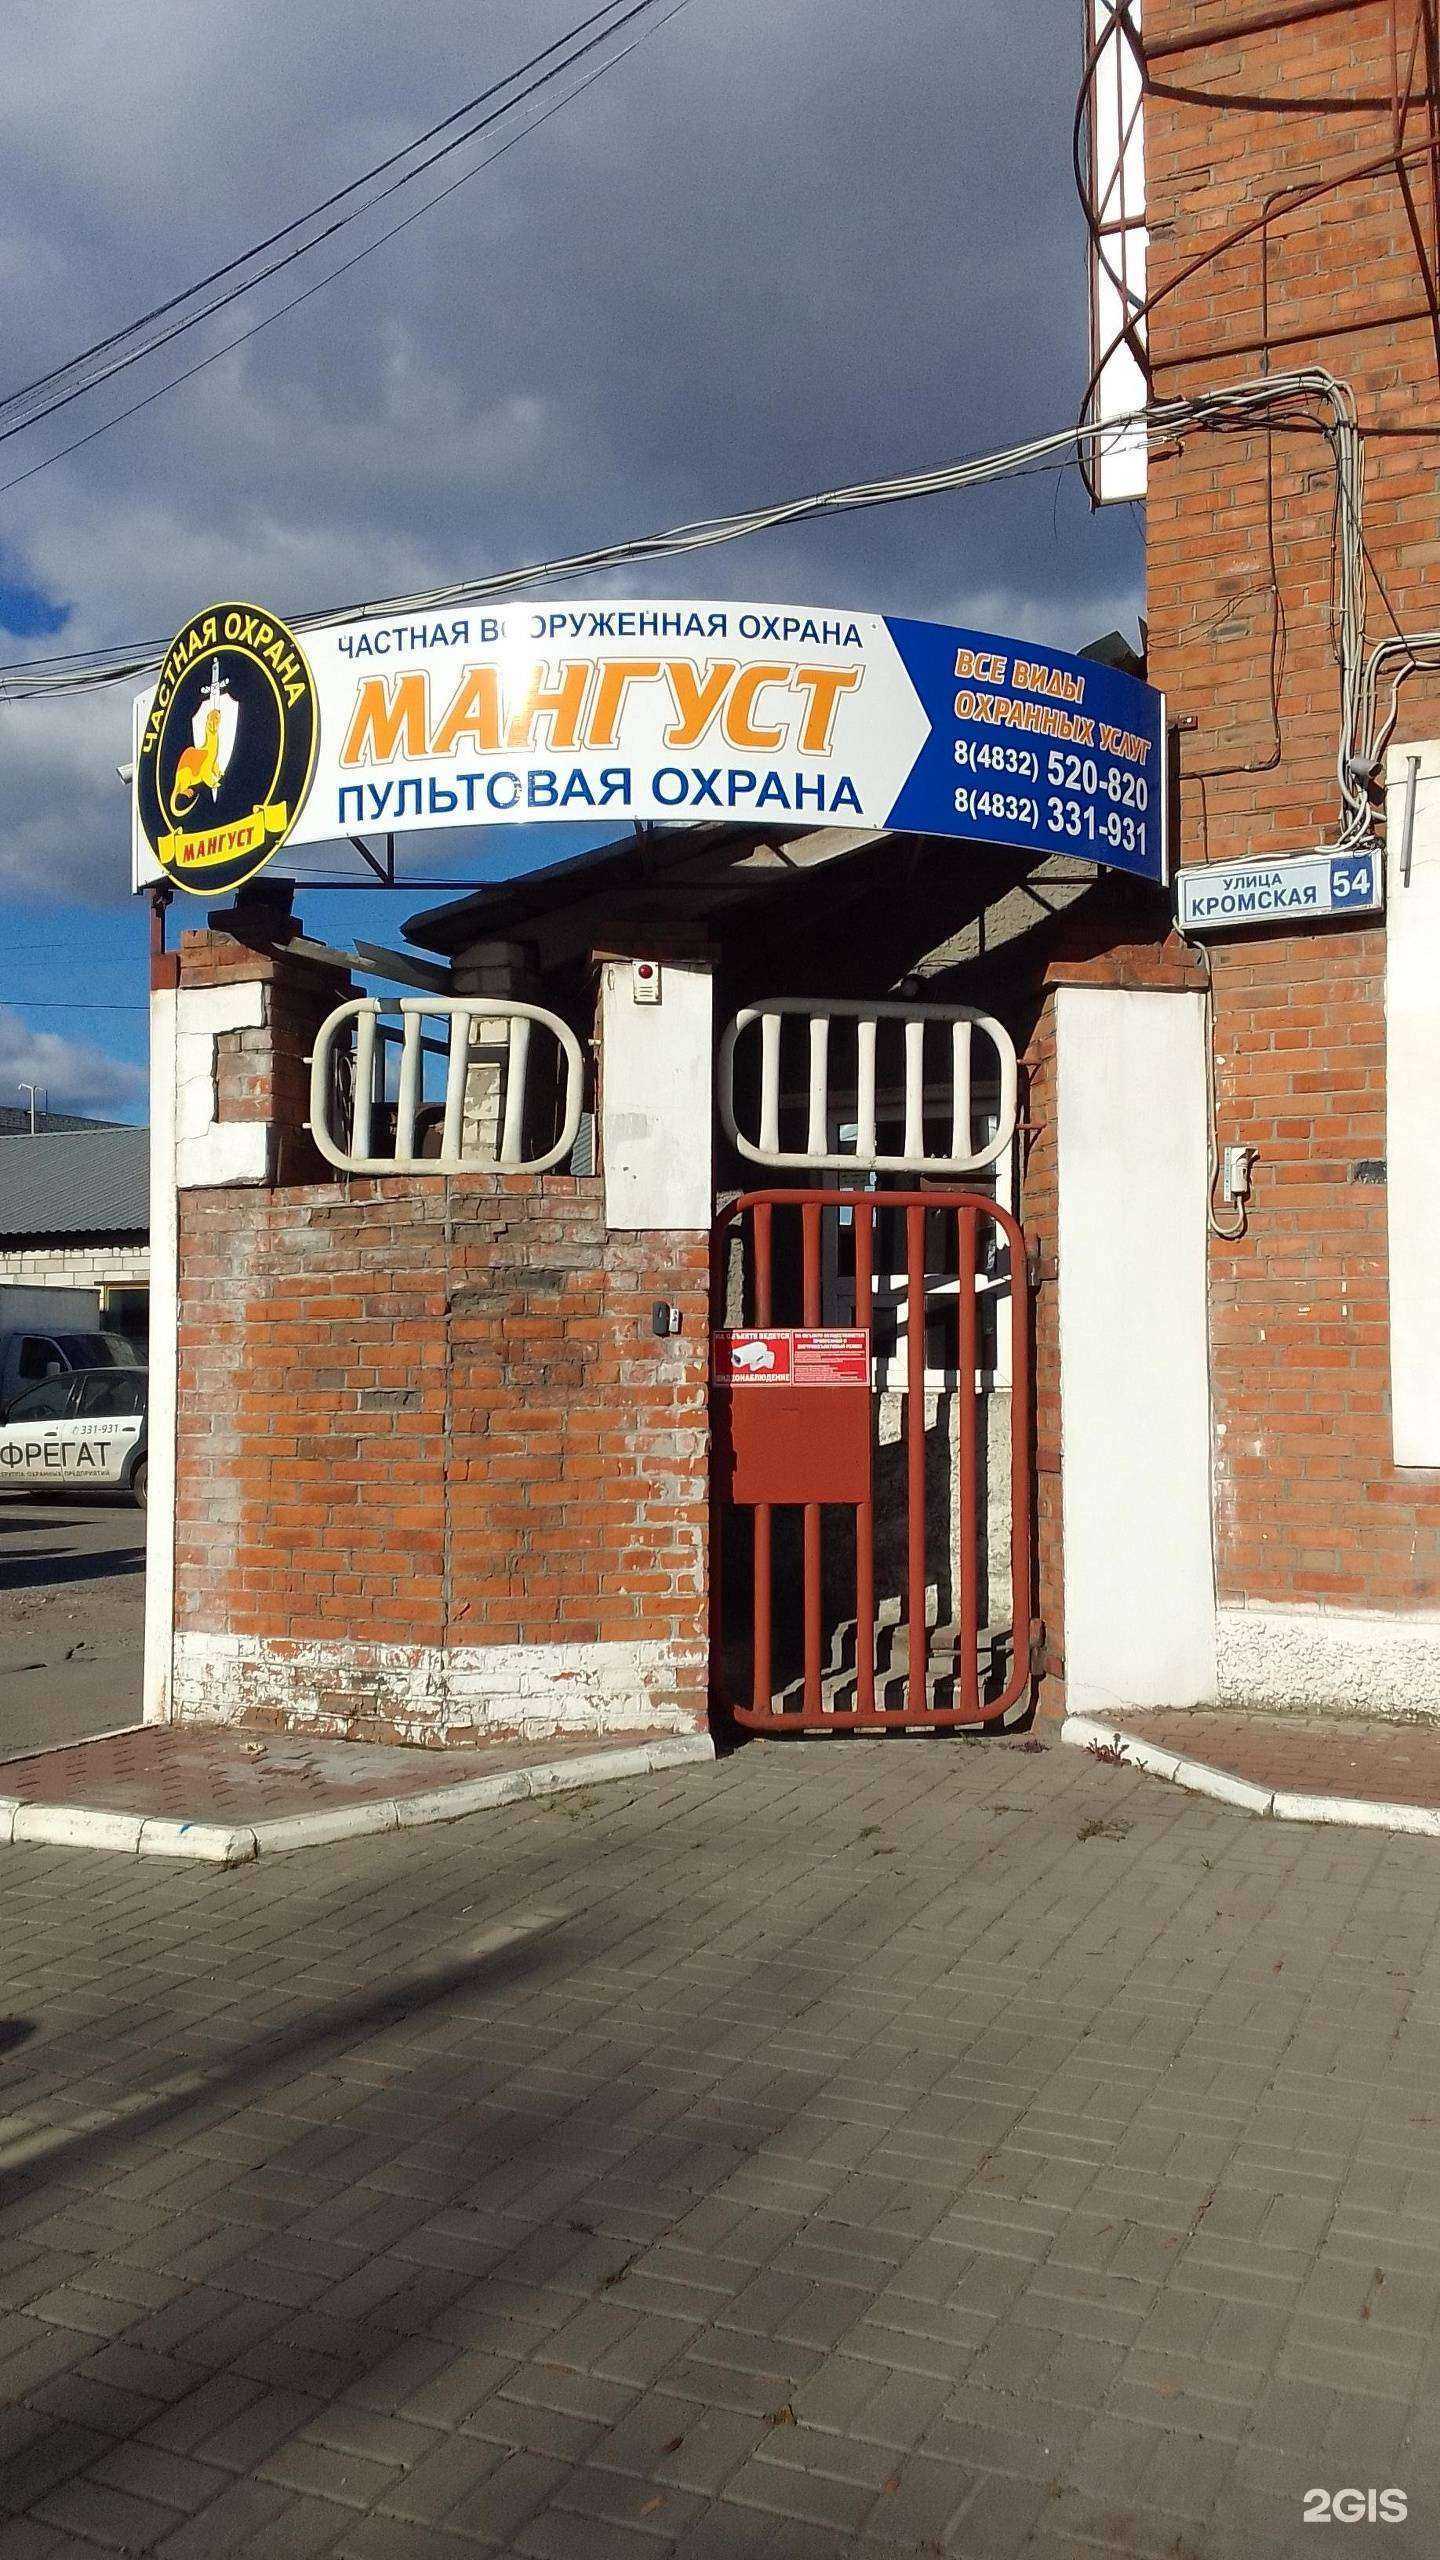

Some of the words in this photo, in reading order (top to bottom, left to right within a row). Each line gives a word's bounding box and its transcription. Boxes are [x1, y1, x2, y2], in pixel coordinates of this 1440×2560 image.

[338, 620, 469, 659] ЧАСТНАЯ
[481, 611, 727, 642] ВОРУЖЕННАЯ
[739, 614, 864, 648] ОХРАНА
[143, 616, 217, 753] ЧАСТНАЯ
[224, 612, 306, 709] ОХРАНА
[955, 648, 1007, 685] ВСЕ
[1011, 659, 1086, 704] ВИДЫ
[340, 657, 866, 767] МАНГУСТ
[954, 690, 1095, 747] ОХРАННЫХ
[1098, 722, 1152, 766] УСЛУГ
[338, 768, 631, 824] ПУЛЬТОВАЯ
[652, 768, 864, 815] ОХРАНА
[954, 740, 1039, 783] 8(4832)
[1047, 751, 1148, 811] 520-820
[183, 826, 256, 864] МАНГУСТ
[954, 788, 1039, 830] 8(4832)
[1047, 797, 1146, 855] 331-931
[1191, 885, 1317, 917] КРОМСКАЯ
[1222, 873, 1282, 891] УЛИЦА
[1332, 868, 1370, 897] 54
[0, 1442, 111, 1468] ФРЕГАТ
[80, 1424, 119, 1435] 331-931
